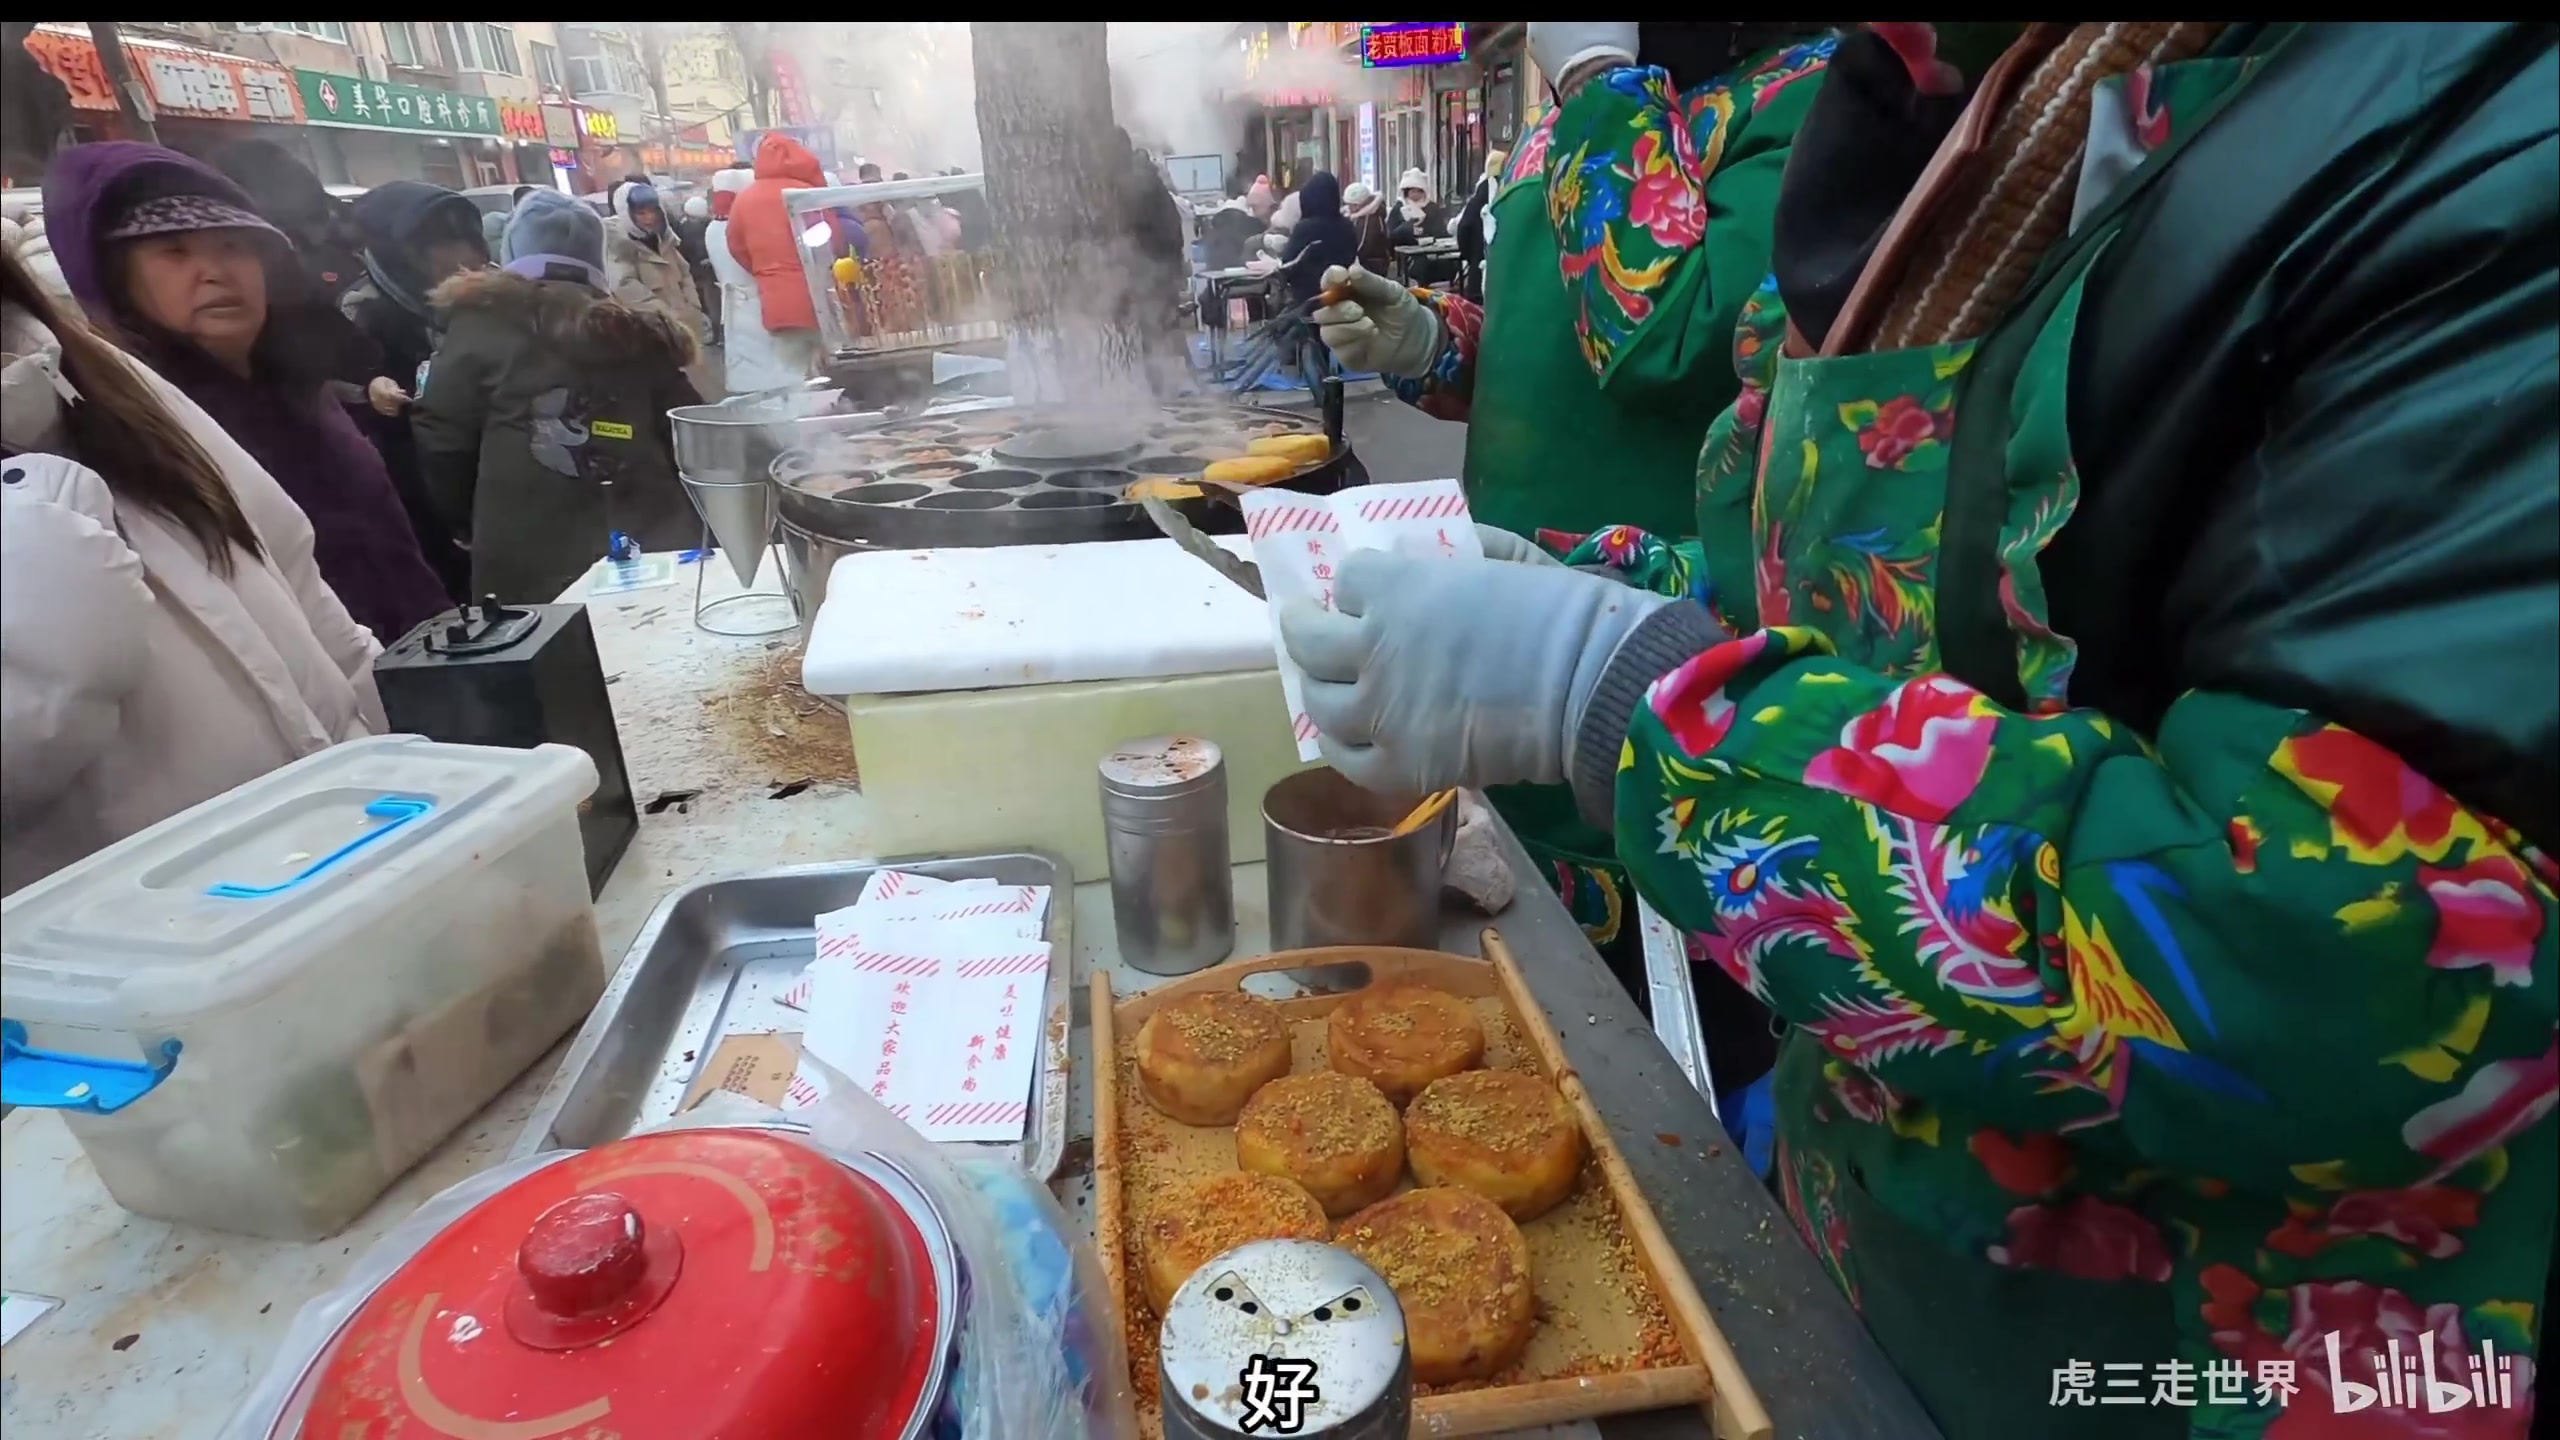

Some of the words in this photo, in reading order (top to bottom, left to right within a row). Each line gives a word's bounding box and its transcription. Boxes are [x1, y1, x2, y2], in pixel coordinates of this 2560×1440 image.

[351, 82, 491, 130] 美华口腔科诊所
[871, 980, 911, 1098] 欢迎大家品尝
[992, 983, 1018, 1061] 美味健康
